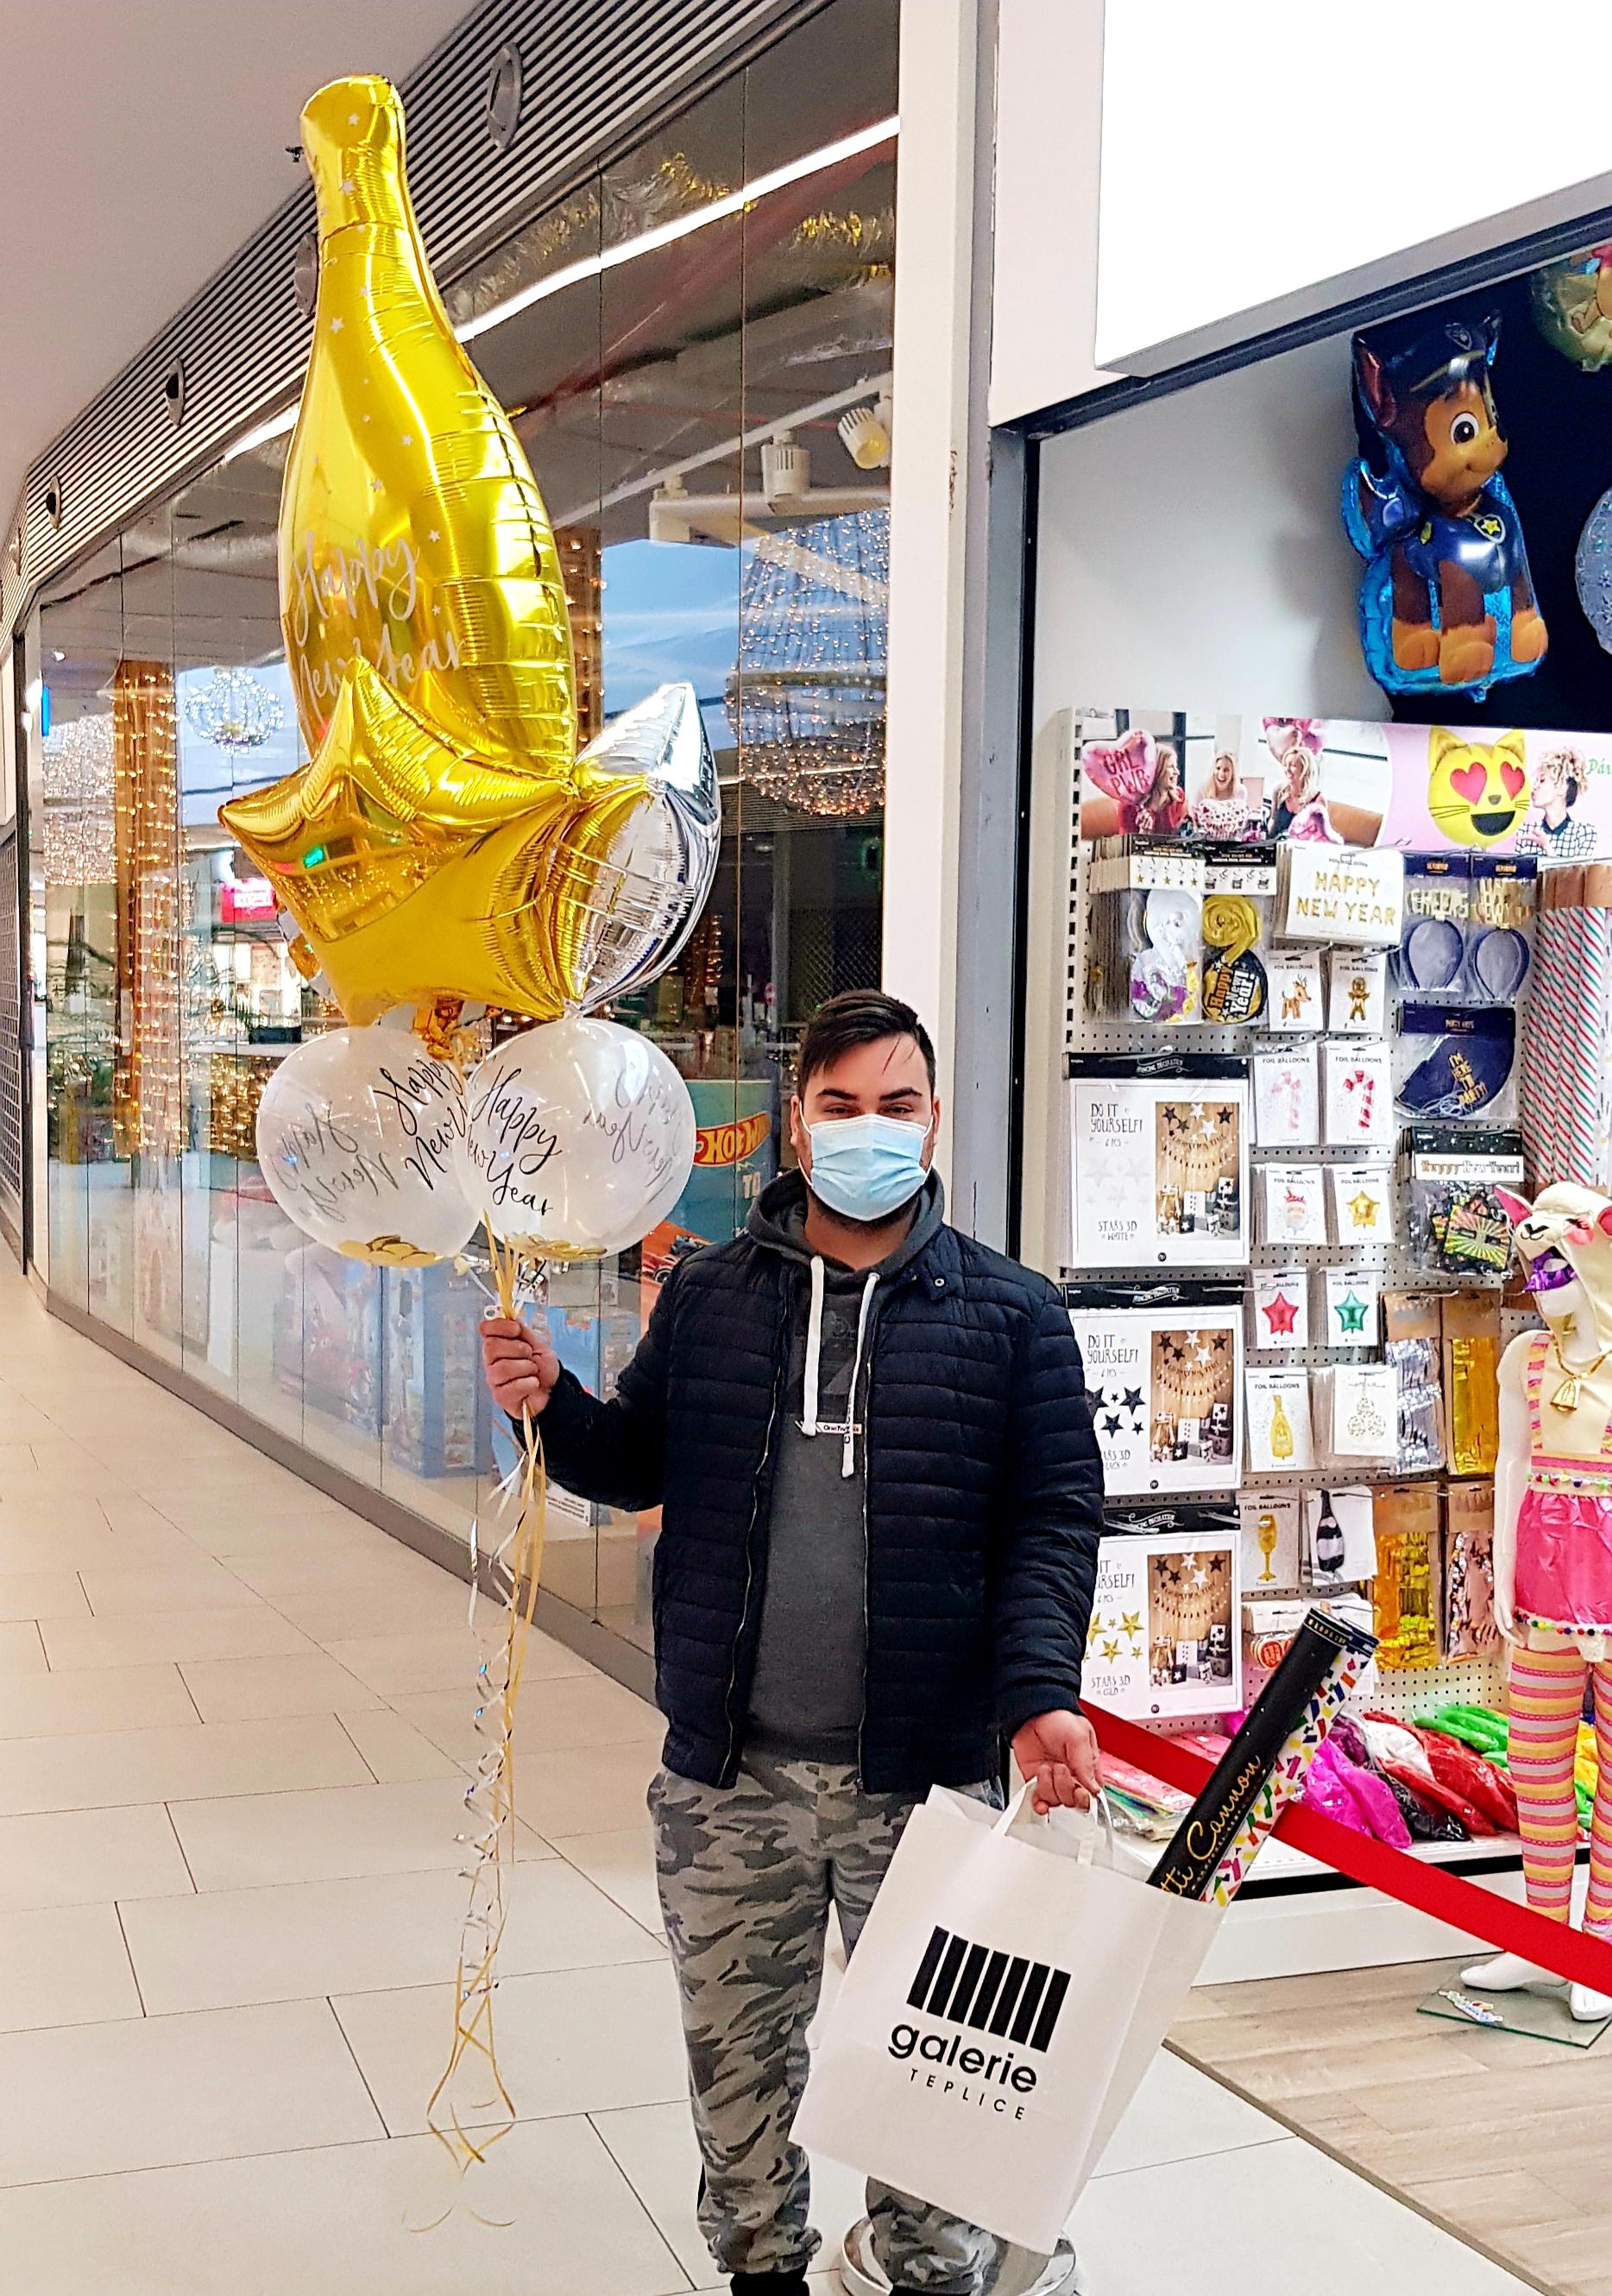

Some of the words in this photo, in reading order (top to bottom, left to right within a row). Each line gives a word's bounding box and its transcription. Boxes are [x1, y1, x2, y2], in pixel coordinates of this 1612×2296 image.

[293, 530, 420, 647] Happy
[1103, 748, 1139, 775] GRL
[1111, 768, 1150, 795] PWR
[1314, 871, 1380, 897] HAPPY
[1296, 896, 1338, 919] NEW
[1344, 901, 1395, 926] YEAR
[1209, 966, 1233, 1007] Happy
[1225, 975, 1243, 1001] New
[373, 1058, 464, 1136] Happy
[1091, 1102, 1104, 1117] DO
[1107, 1103, 1119, 1117] IT
[472, 1065, 563, 1175] Happy
[1090, 1118, 1143, 1133] YOURSELF!
[405, 1120, 456, 1191] New
[486, 1151, 554, 1215] Year
[1098, 1221, 1124, 1232] STARS
[1126, 1221, 1137, 1231] 3D
[1087, 1334, 1101, 1348] DO
[1104, 1334, 1116, 1348] IT
[1086, 1348, 1138, 1365] YOURSELF!
[1091, 1678, 1117, 1688] STARS
[1187, 1755, 1262, 1861] Cannon
[887, 2023, 1037, 2092] galerie
[910, 2068, 1025, 2120] TEPLICE
